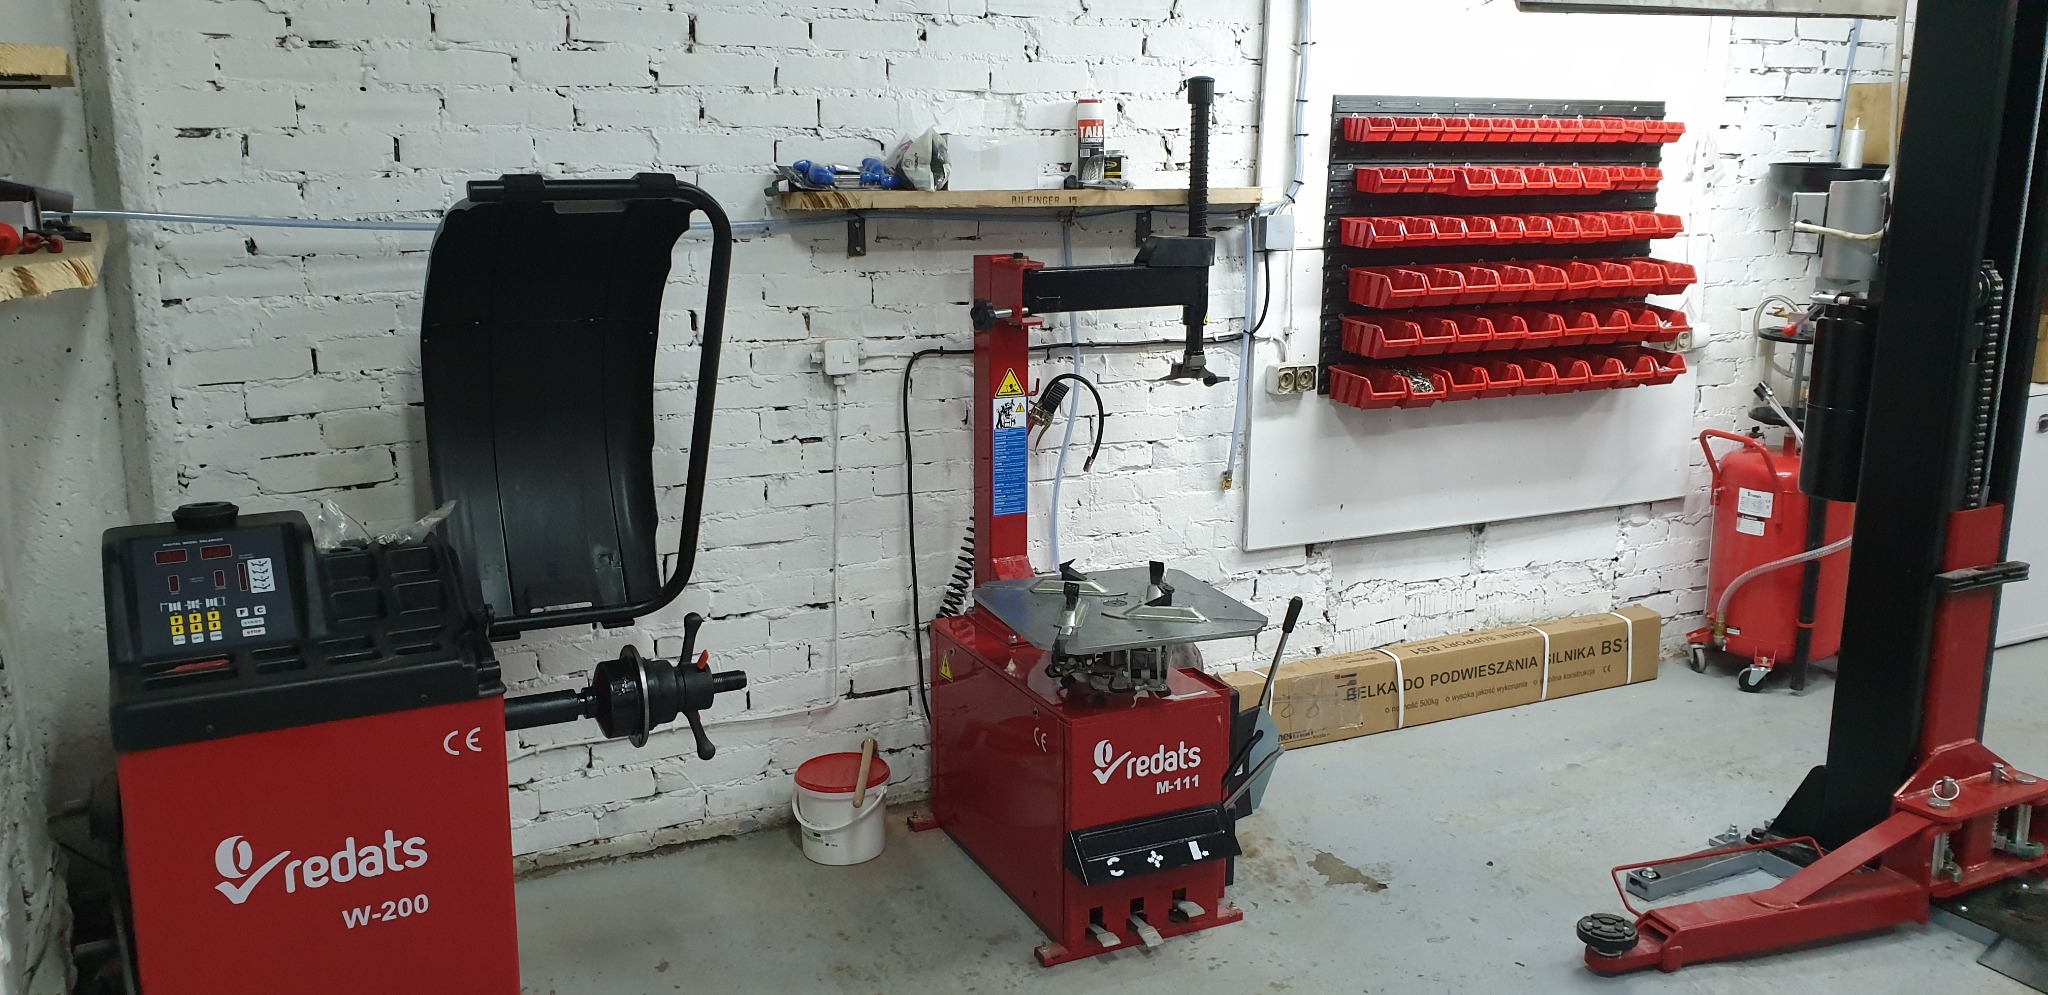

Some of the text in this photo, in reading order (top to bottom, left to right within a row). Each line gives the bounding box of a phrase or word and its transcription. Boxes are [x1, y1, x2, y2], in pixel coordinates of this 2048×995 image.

[1079, 125, 1103, 138] TALK
[1410, 645, 1441, 655] BS1
[1442, 636, 1496, 649] SUPPORT
[1403, 676, 1425, 692] DO
[1430, 656, 1538, 686] PODWIESZANIA
[1420, 698, 1439, 708] 500kg
[1452, 691, 1475, 702] wysoka
[1475, 686, 1495, 698] jakość
[1496, 680, 1528, 694] wykonania
[1126, 741, 1202, 779] redats
[1156, 774, 1200, 795] M-111
[284, 829, 428, 894] redats
[341, 894, 429, 929] W-200
